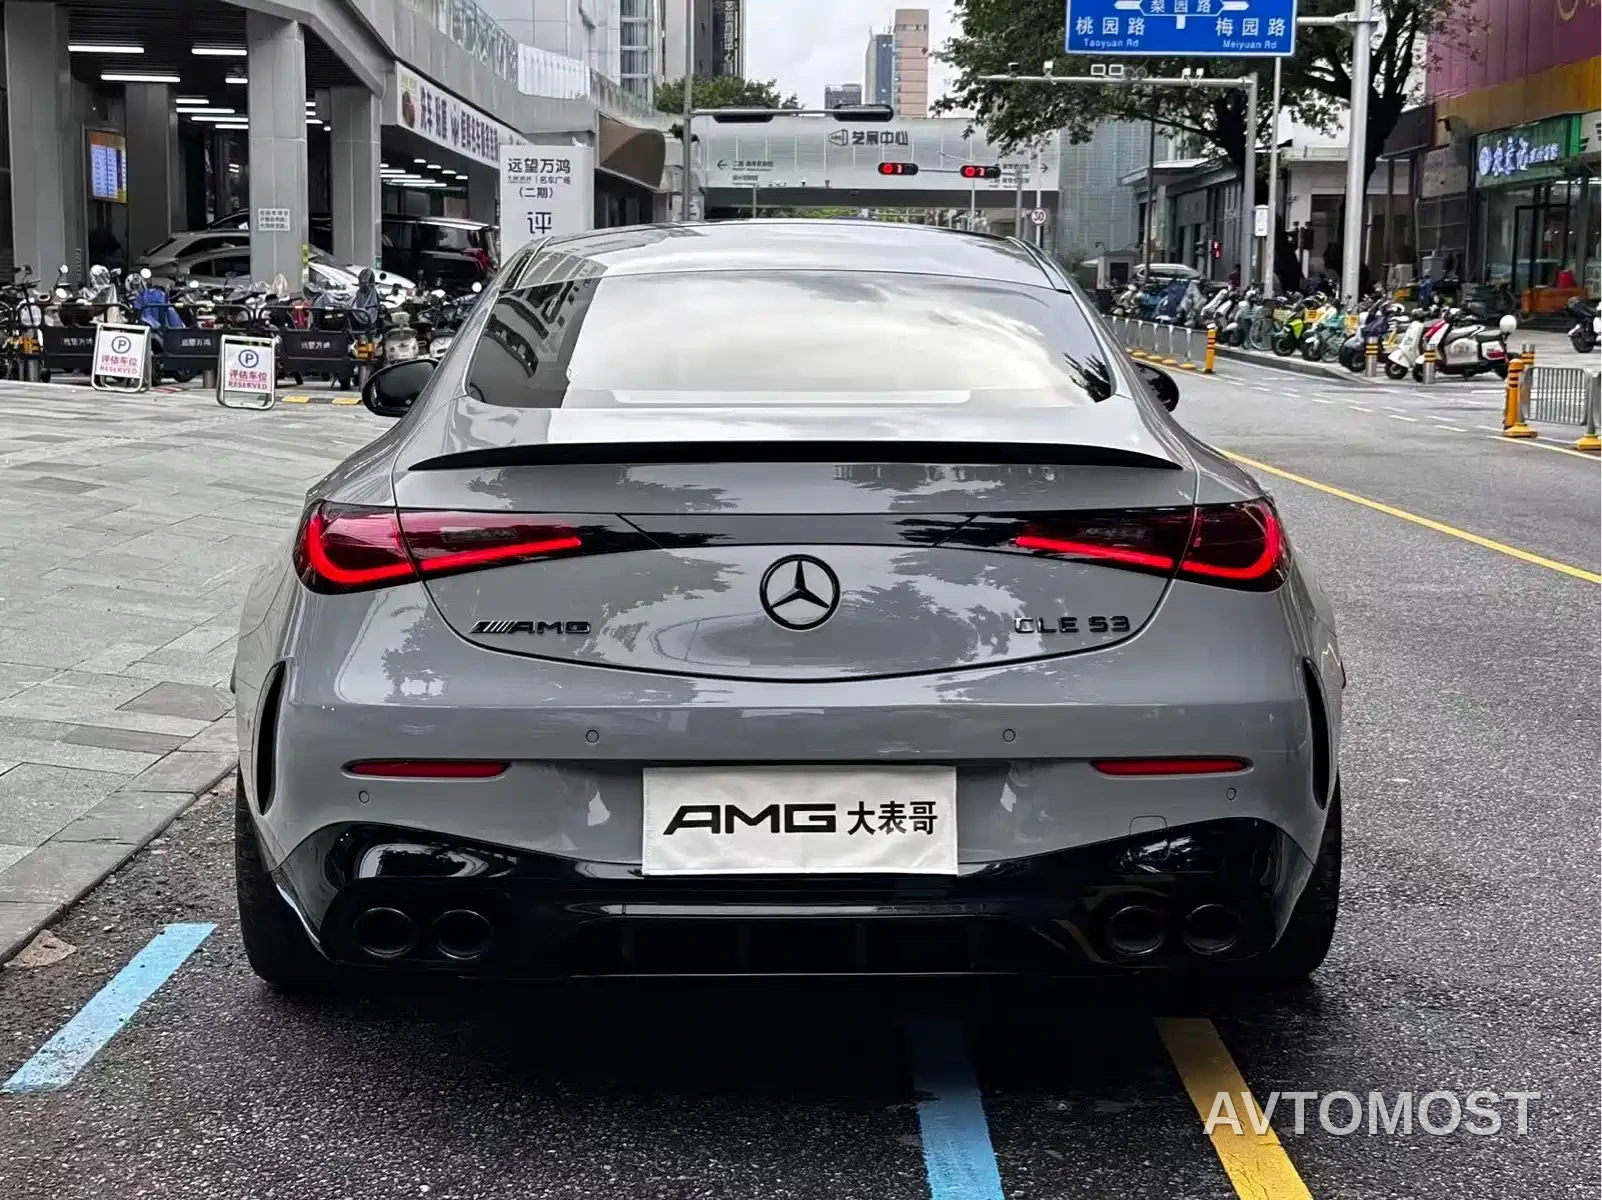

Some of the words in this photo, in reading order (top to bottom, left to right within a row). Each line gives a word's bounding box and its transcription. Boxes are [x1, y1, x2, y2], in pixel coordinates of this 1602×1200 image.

[1150, 0, 1212, 13] 梨园路
[1075, 16, 1145, 36] 桃园路
[1215, 17, 1285, 37] 梅园路
[1084, 38, 1123, 49] Taoyuan
[1126, 38, 1139, 48] Rd
[1222, 40, 1261, 50] Meiyuan
[1264, 40, 1278, 50] Rd
[852, 131, 909, 146] 艺展中心
[508, 158, 570, 174] 远望万鸿
[540, 176, 570, 184] 名车广场
[527, 211, 552, 234] 评
[102, 355, 137, 366] 评估车位
[100, 366, 138, 375] RESERVED
[230, 370, 268, 381] 评估车位
[228, 381, 268, 390] RESERVED
[1014, 616, 1079, 634] CLE
[1088, 615, 1131, 633] 53
[663, 803, 837, 836] AMG
[847, 801, 939, 836] 大表哥
